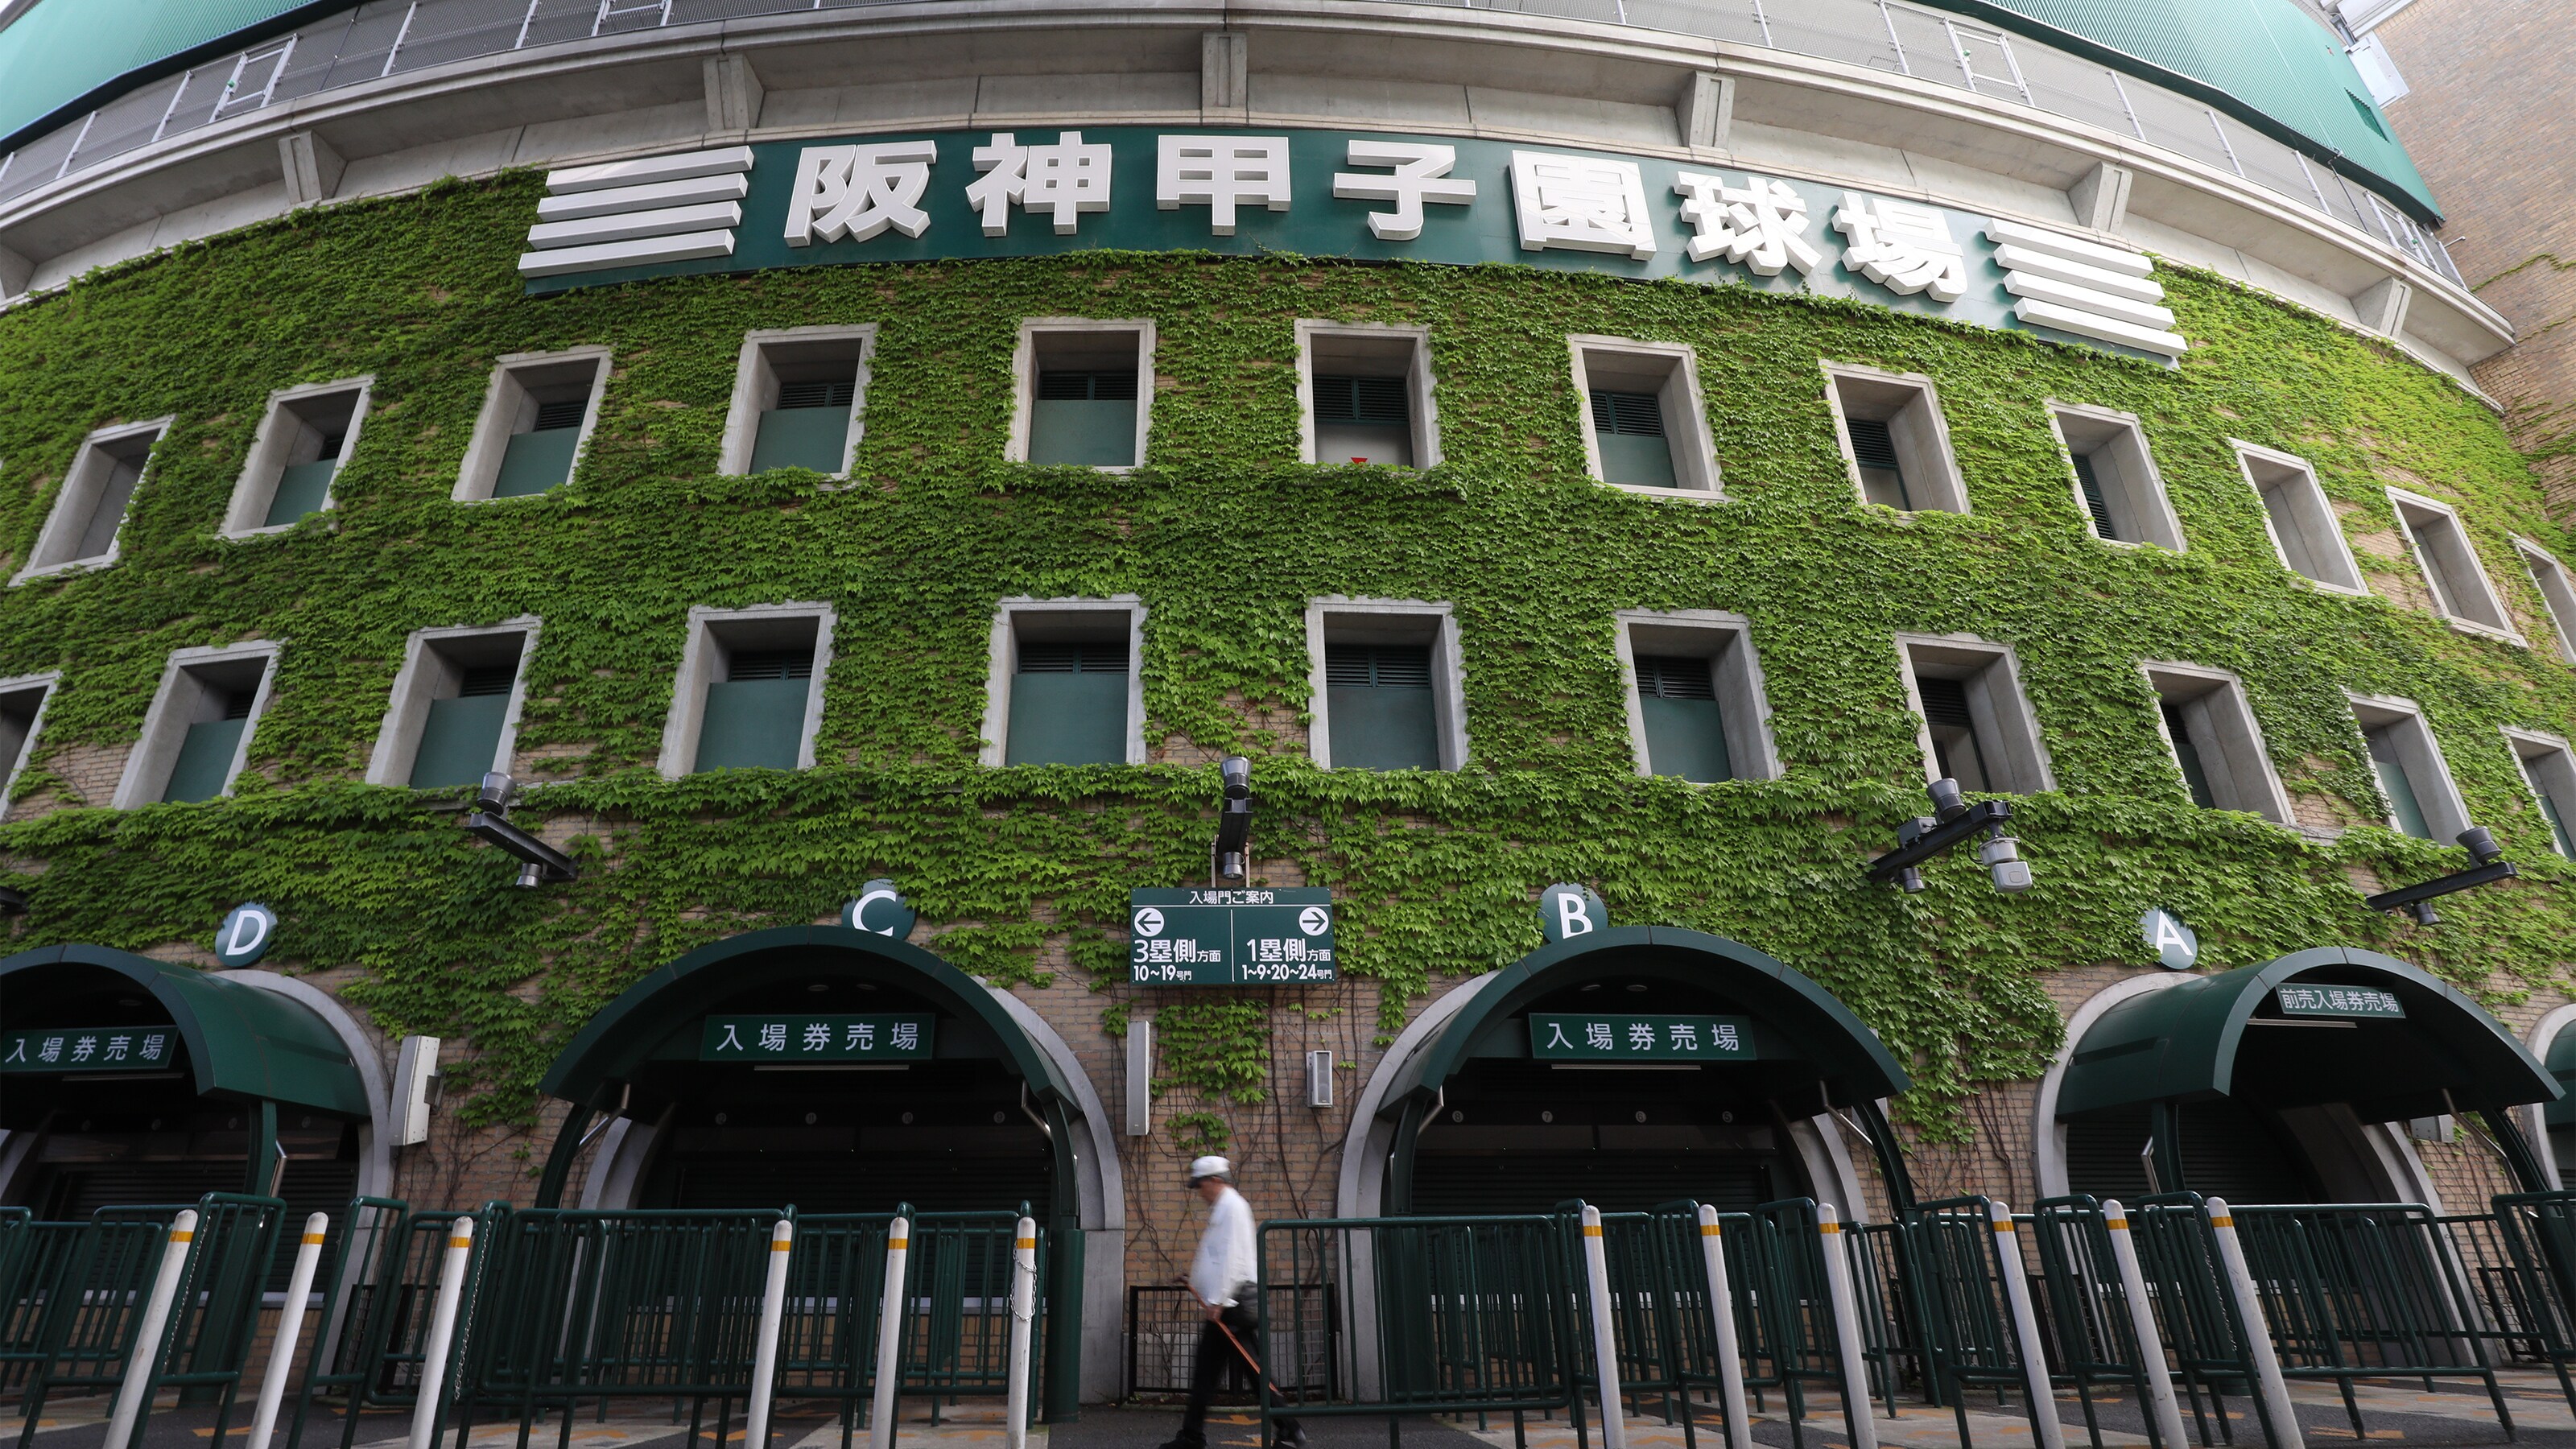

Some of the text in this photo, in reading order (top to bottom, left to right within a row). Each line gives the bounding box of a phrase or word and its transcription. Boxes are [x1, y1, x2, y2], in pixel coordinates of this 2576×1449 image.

[784, 130, 1969, 302] 阪神甲子園球場
[1189, 890, 1274, 905] 入場門ご案内
[852, 890, 897, 937] C
[1558, 893, 1593, 939] B
[225, 910, 268, 956] D
[2156, 909, 2194, 956] A
[1133, 938, 1221, 964] 3塁側方面
[1246, 938, 1331, 963] 1塁側方面
[2280, 989, 2399, 1013] 前売入場券売場
[5, 1034, 165, 1063] 入場券売場
[716, 1022, 919, 1052] 入場券売場
[1546, 1022, 1739, 1051] 入場券売場
